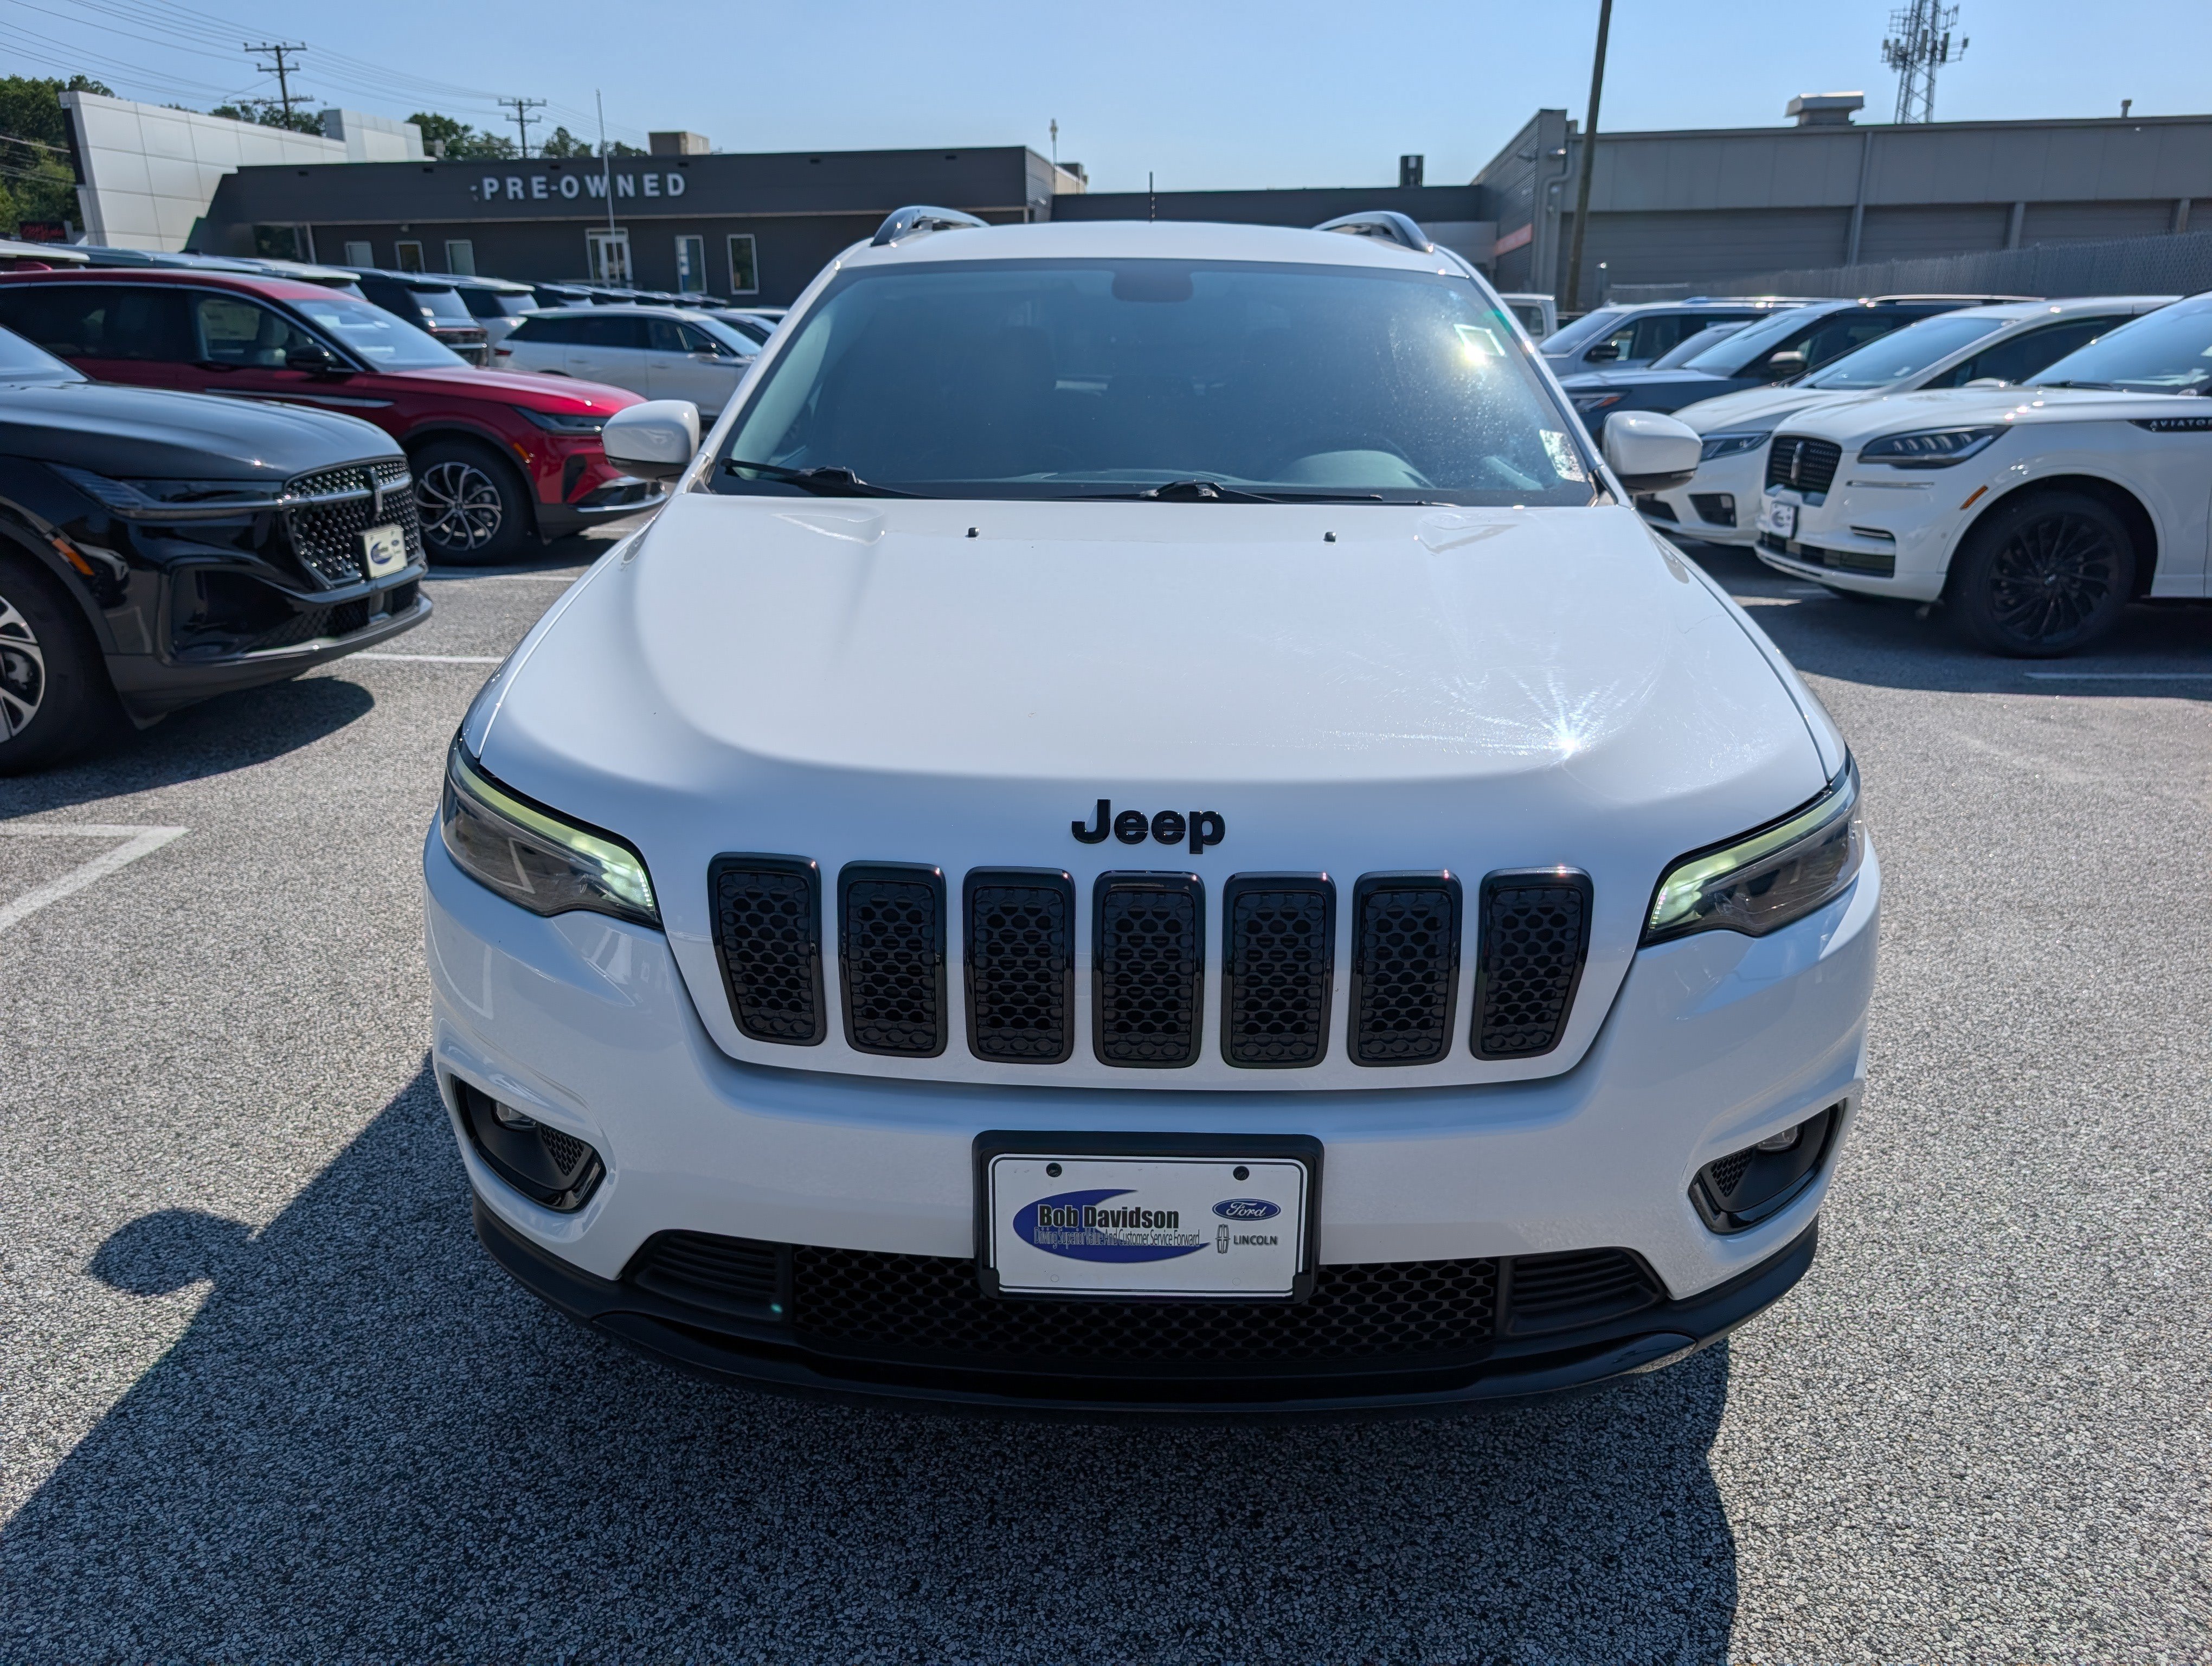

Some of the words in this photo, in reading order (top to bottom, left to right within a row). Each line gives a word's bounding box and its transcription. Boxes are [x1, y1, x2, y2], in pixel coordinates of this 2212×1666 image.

[482, 173, 685, 200] PRE-OWNED
[1071, 799, 1225, 854] Jeep
[1038, 1204, 1079, 1228] Bob
[1083, 1205, 1179, 1228] Davidson
[1226, 1202, 1267, 1216] Ford
[1034, 1227, 1057, 1248] Driving
[1058, 1227, 1085, 1249] Superior
[1085, 1227, 1103, 1245] Value
[1103, 1228, 1117, 1245] And
[1118, 1228, 1149, 1246] Customer
[1150, 1229, 1172, 1246] Service
[1174, 1229, 1200, 1246] Forward
[1233, 1235, 1278, 1245] LINCOLN
